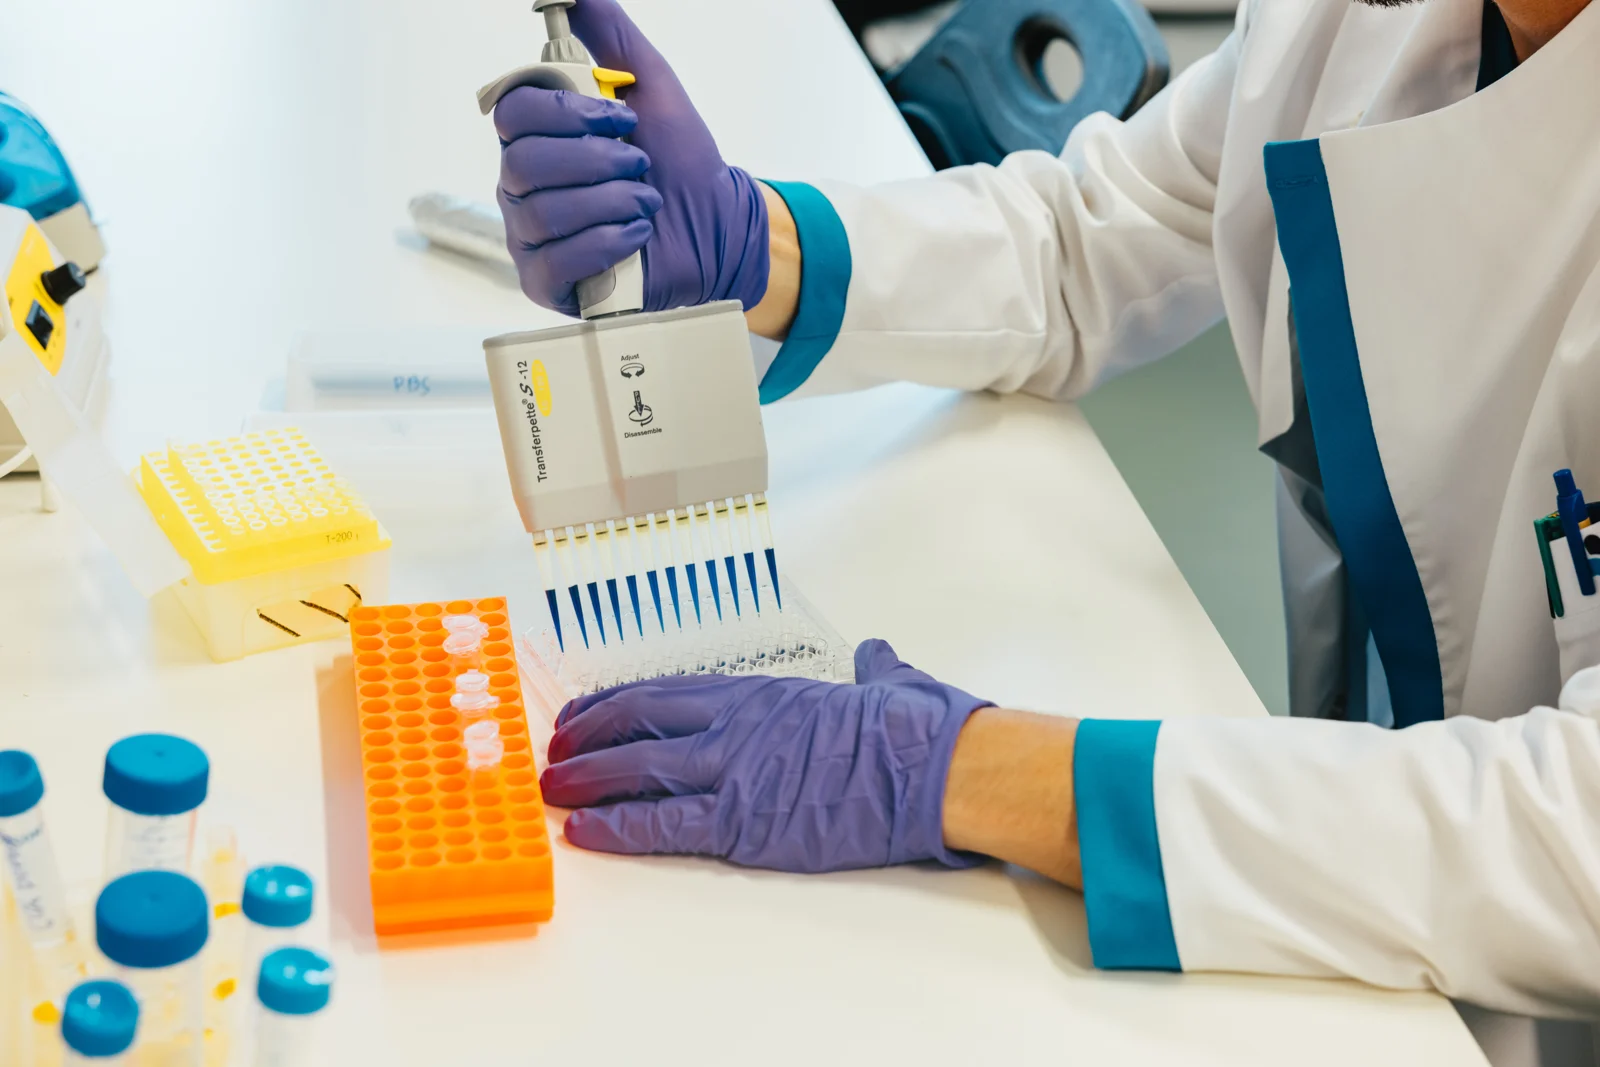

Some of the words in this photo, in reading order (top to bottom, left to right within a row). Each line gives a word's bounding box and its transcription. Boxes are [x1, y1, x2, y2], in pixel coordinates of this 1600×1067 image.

[620, 353, 640, 362] Adjust
[393, 375, 431, 396] PBS
[519, 382, 534, 397] S
[624, 427, 662, 439] Disassemble
